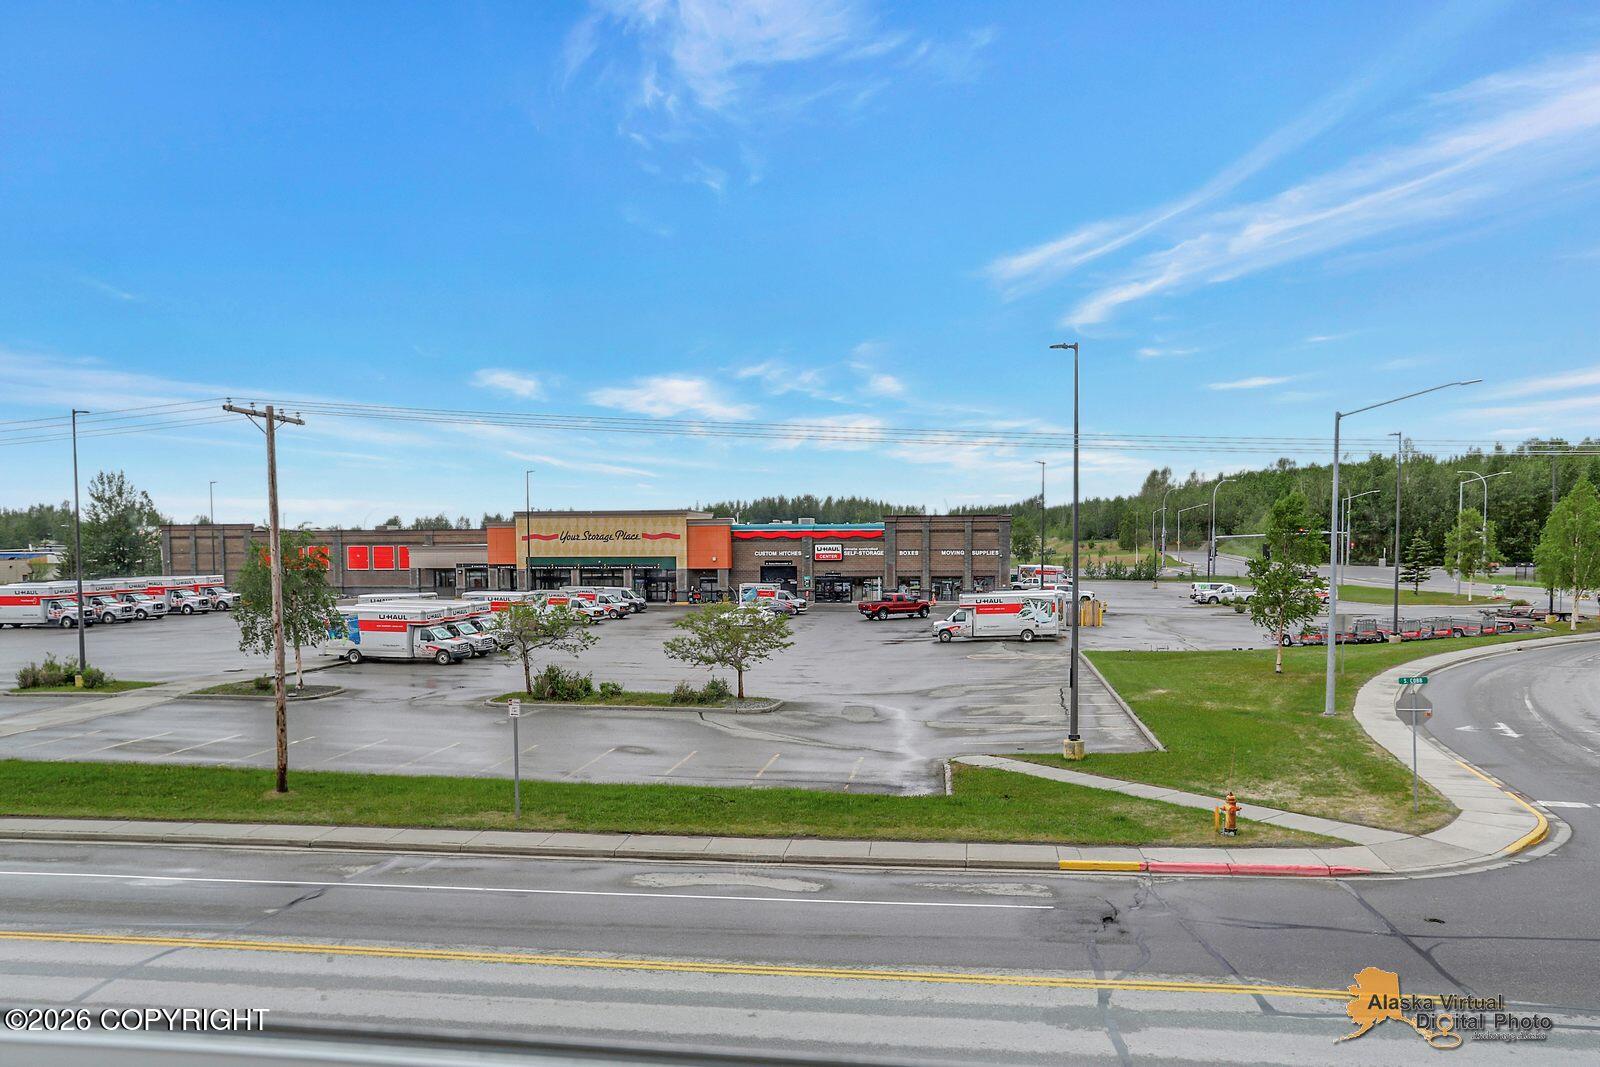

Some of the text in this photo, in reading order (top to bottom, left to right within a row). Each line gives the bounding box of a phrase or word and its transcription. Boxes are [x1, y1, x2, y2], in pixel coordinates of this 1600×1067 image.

[560, 530, 641, 543] Your Storage Place
